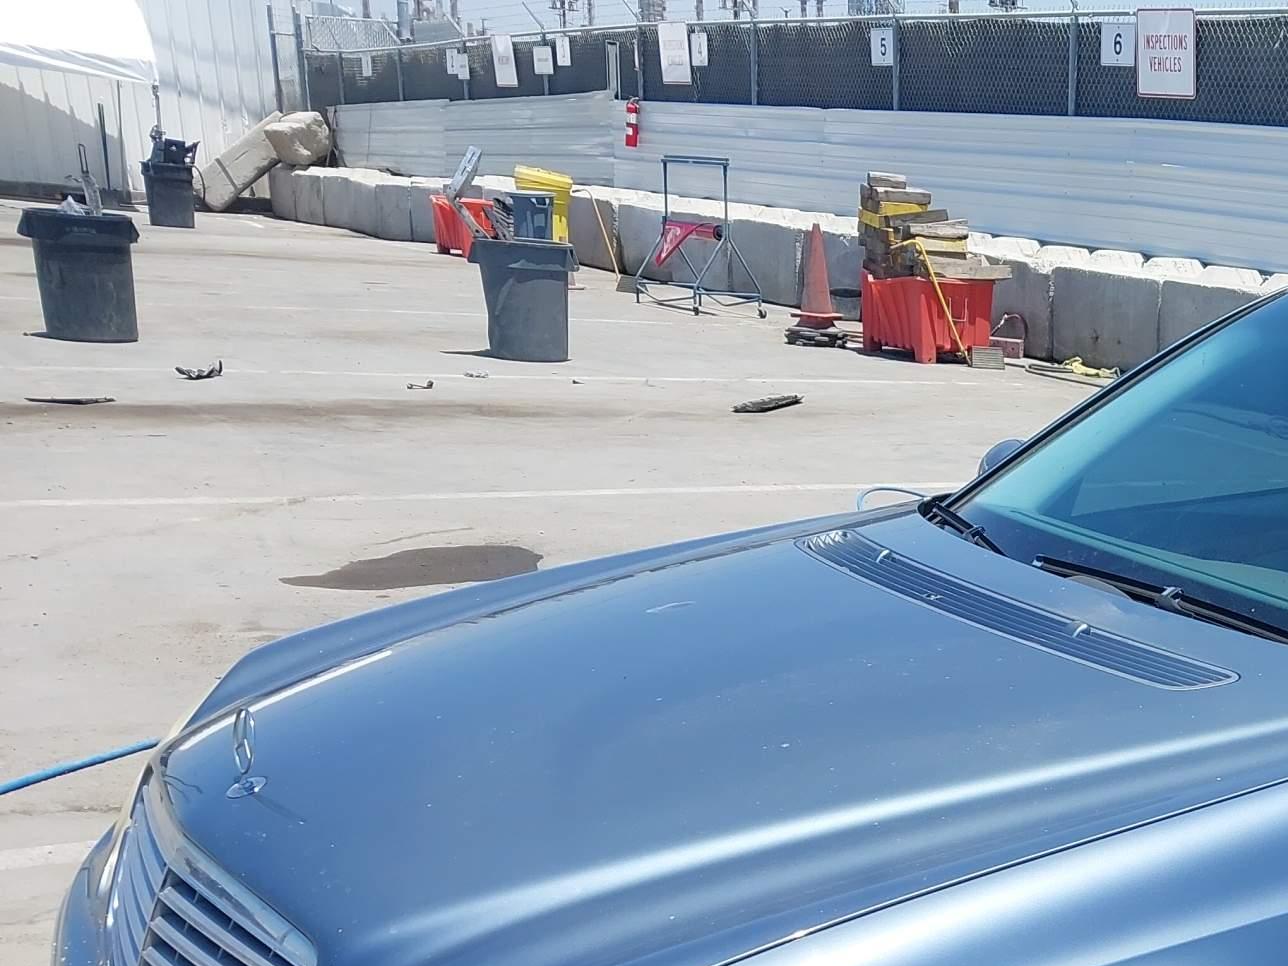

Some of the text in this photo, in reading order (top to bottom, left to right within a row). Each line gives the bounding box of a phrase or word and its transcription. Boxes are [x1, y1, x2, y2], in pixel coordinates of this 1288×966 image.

[880, 37, 886, 56] 5
[1113, 32, 1122, 55] 6
[1143, 34, 1188, 50] INSPECTIONS
[1149, 56, 1182, 72] VEHICLES
